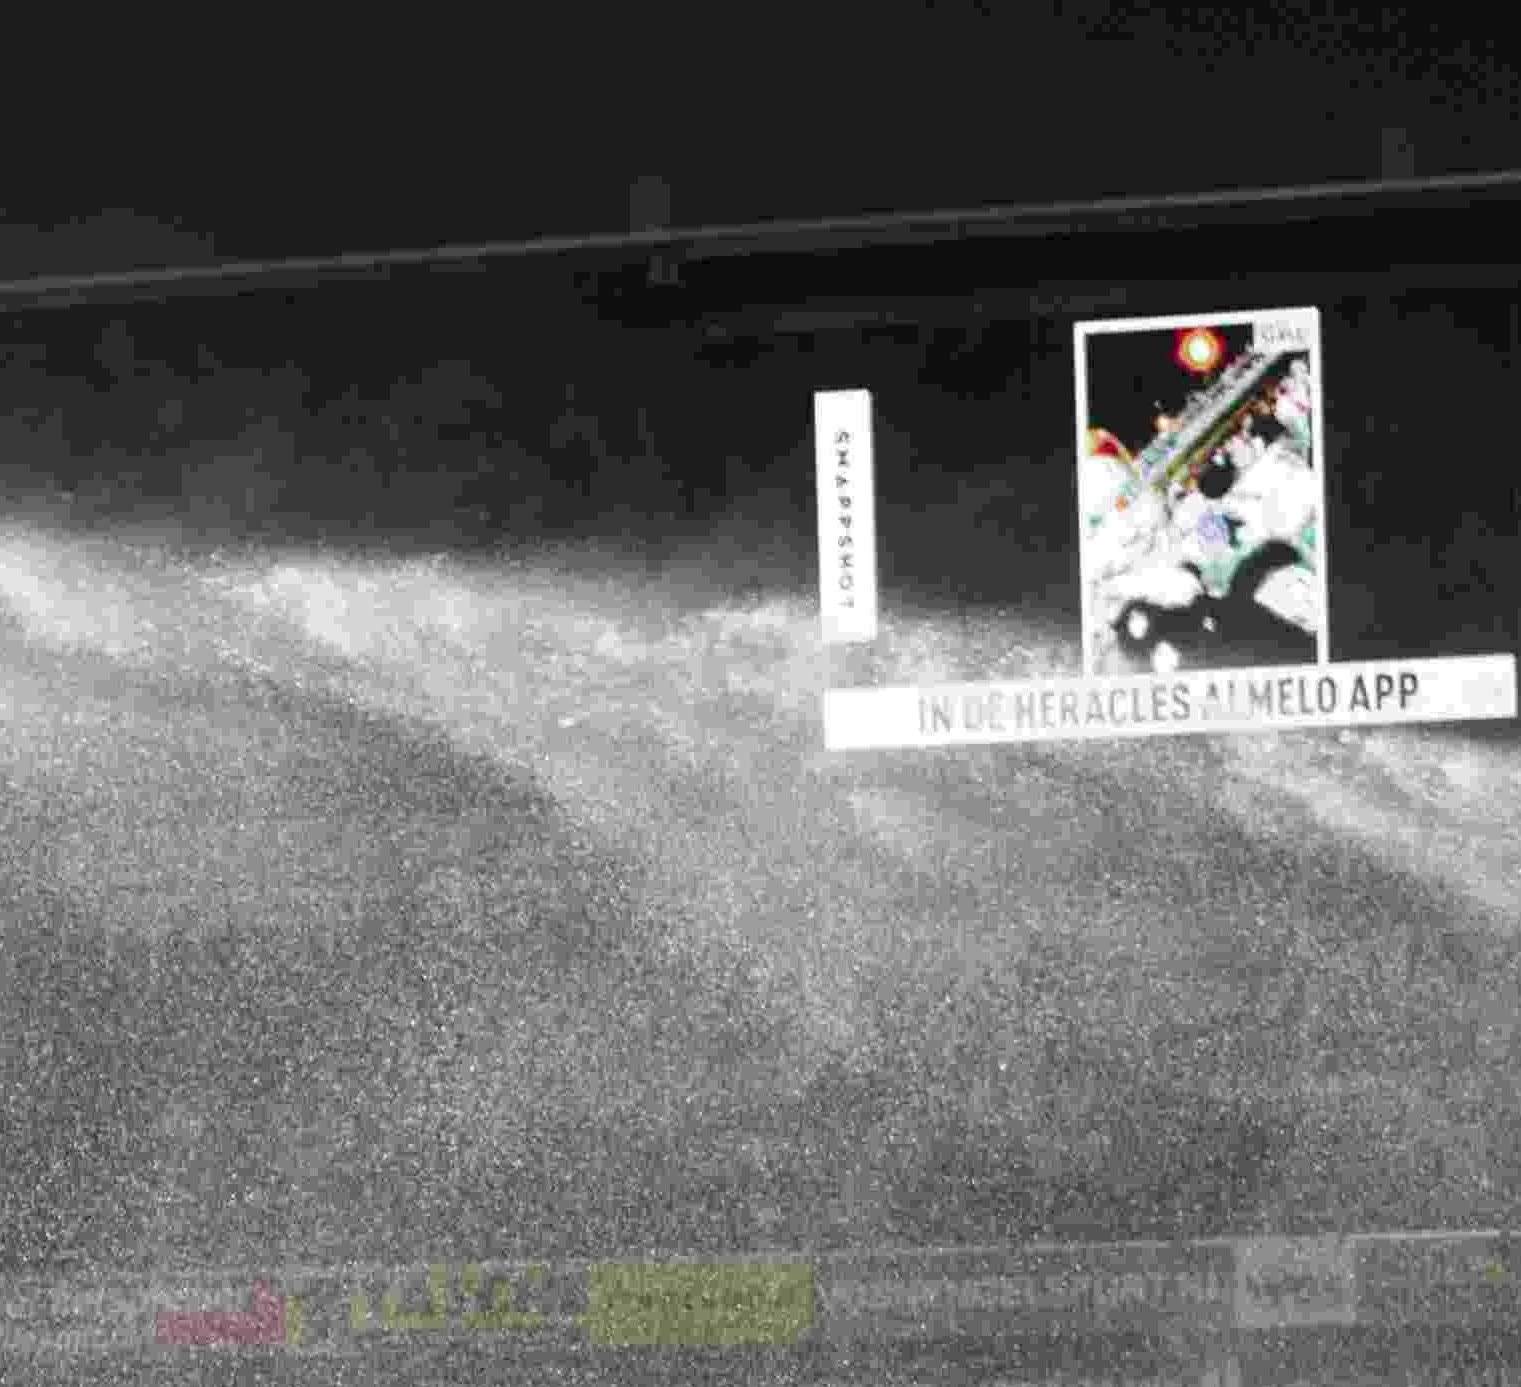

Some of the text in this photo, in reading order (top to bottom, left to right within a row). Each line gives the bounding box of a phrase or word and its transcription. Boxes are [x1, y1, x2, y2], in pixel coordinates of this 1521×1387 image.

[917, 695, 952, 735] IN
[1014, 681, 1192, 732] HERACLES
[1348, 670, 1421, 713] APP
